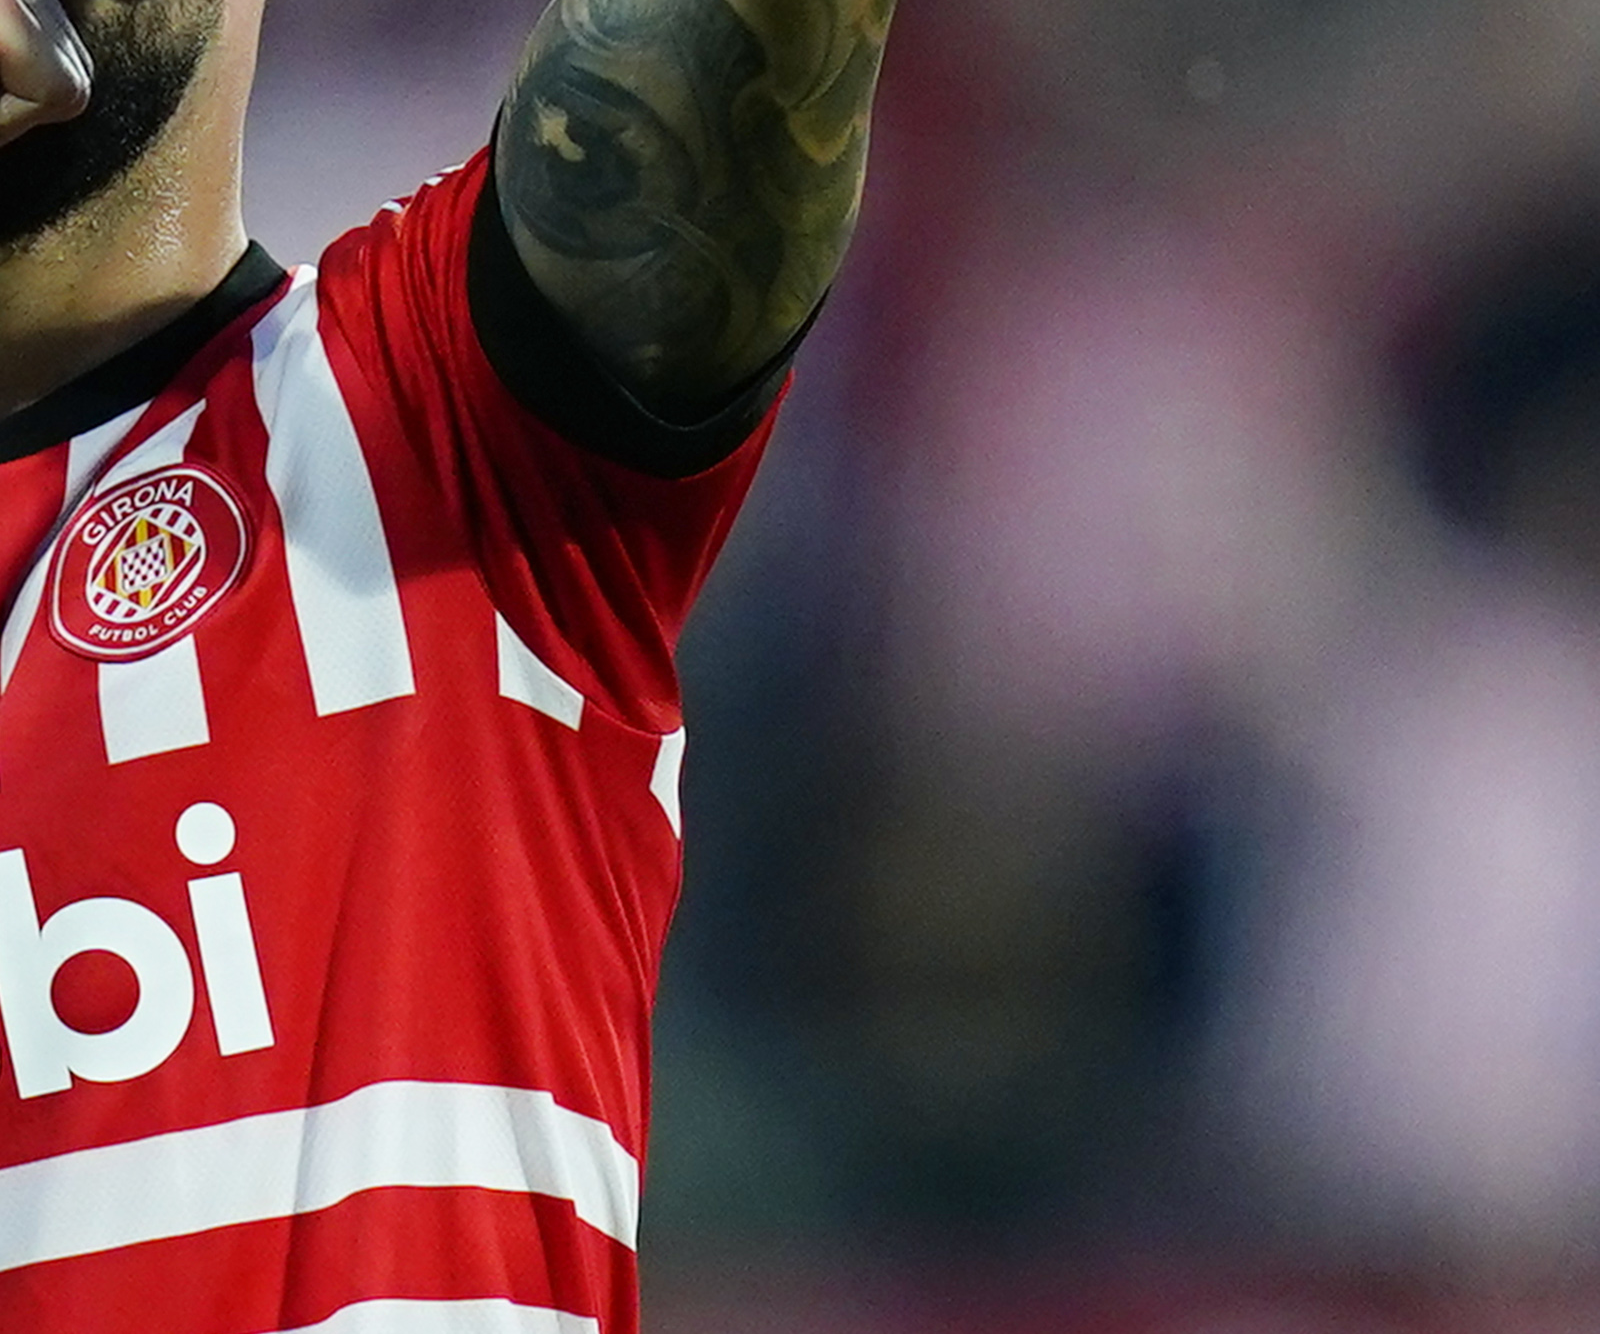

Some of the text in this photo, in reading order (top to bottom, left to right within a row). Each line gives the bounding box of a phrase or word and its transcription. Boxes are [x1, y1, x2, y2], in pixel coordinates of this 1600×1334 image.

[81, 479, 194, 545] GIRONA
[88, 585, 208, 642] FUTBOL CLUB
